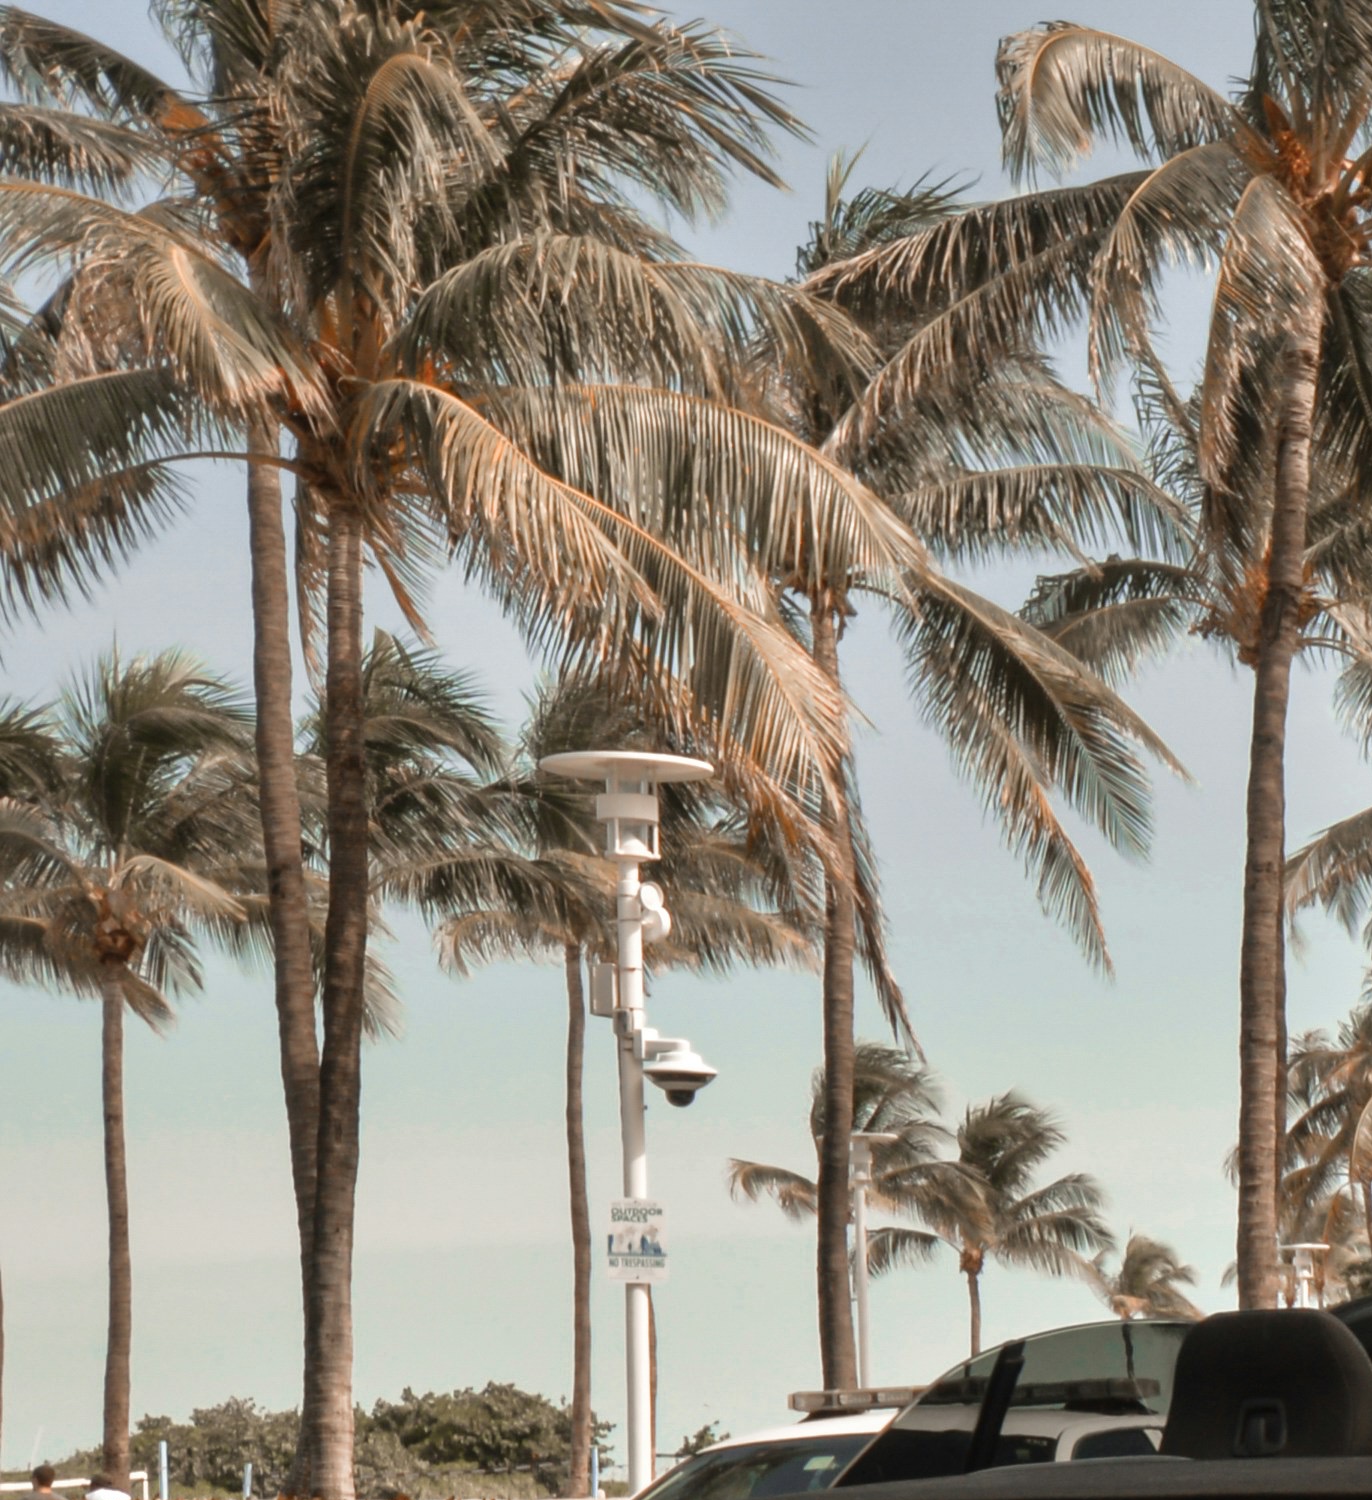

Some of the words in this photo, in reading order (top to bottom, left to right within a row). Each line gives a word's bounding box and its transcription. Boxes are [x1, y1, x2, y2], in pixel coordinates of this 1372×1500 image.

[611, 1207, 663, 1216] OUTDOOR
[611, 1214, 648, 1223] SPACES
[609, 1258, 619, 1268] NO
[621, 1258, 666, 1269] TRESPASSING
